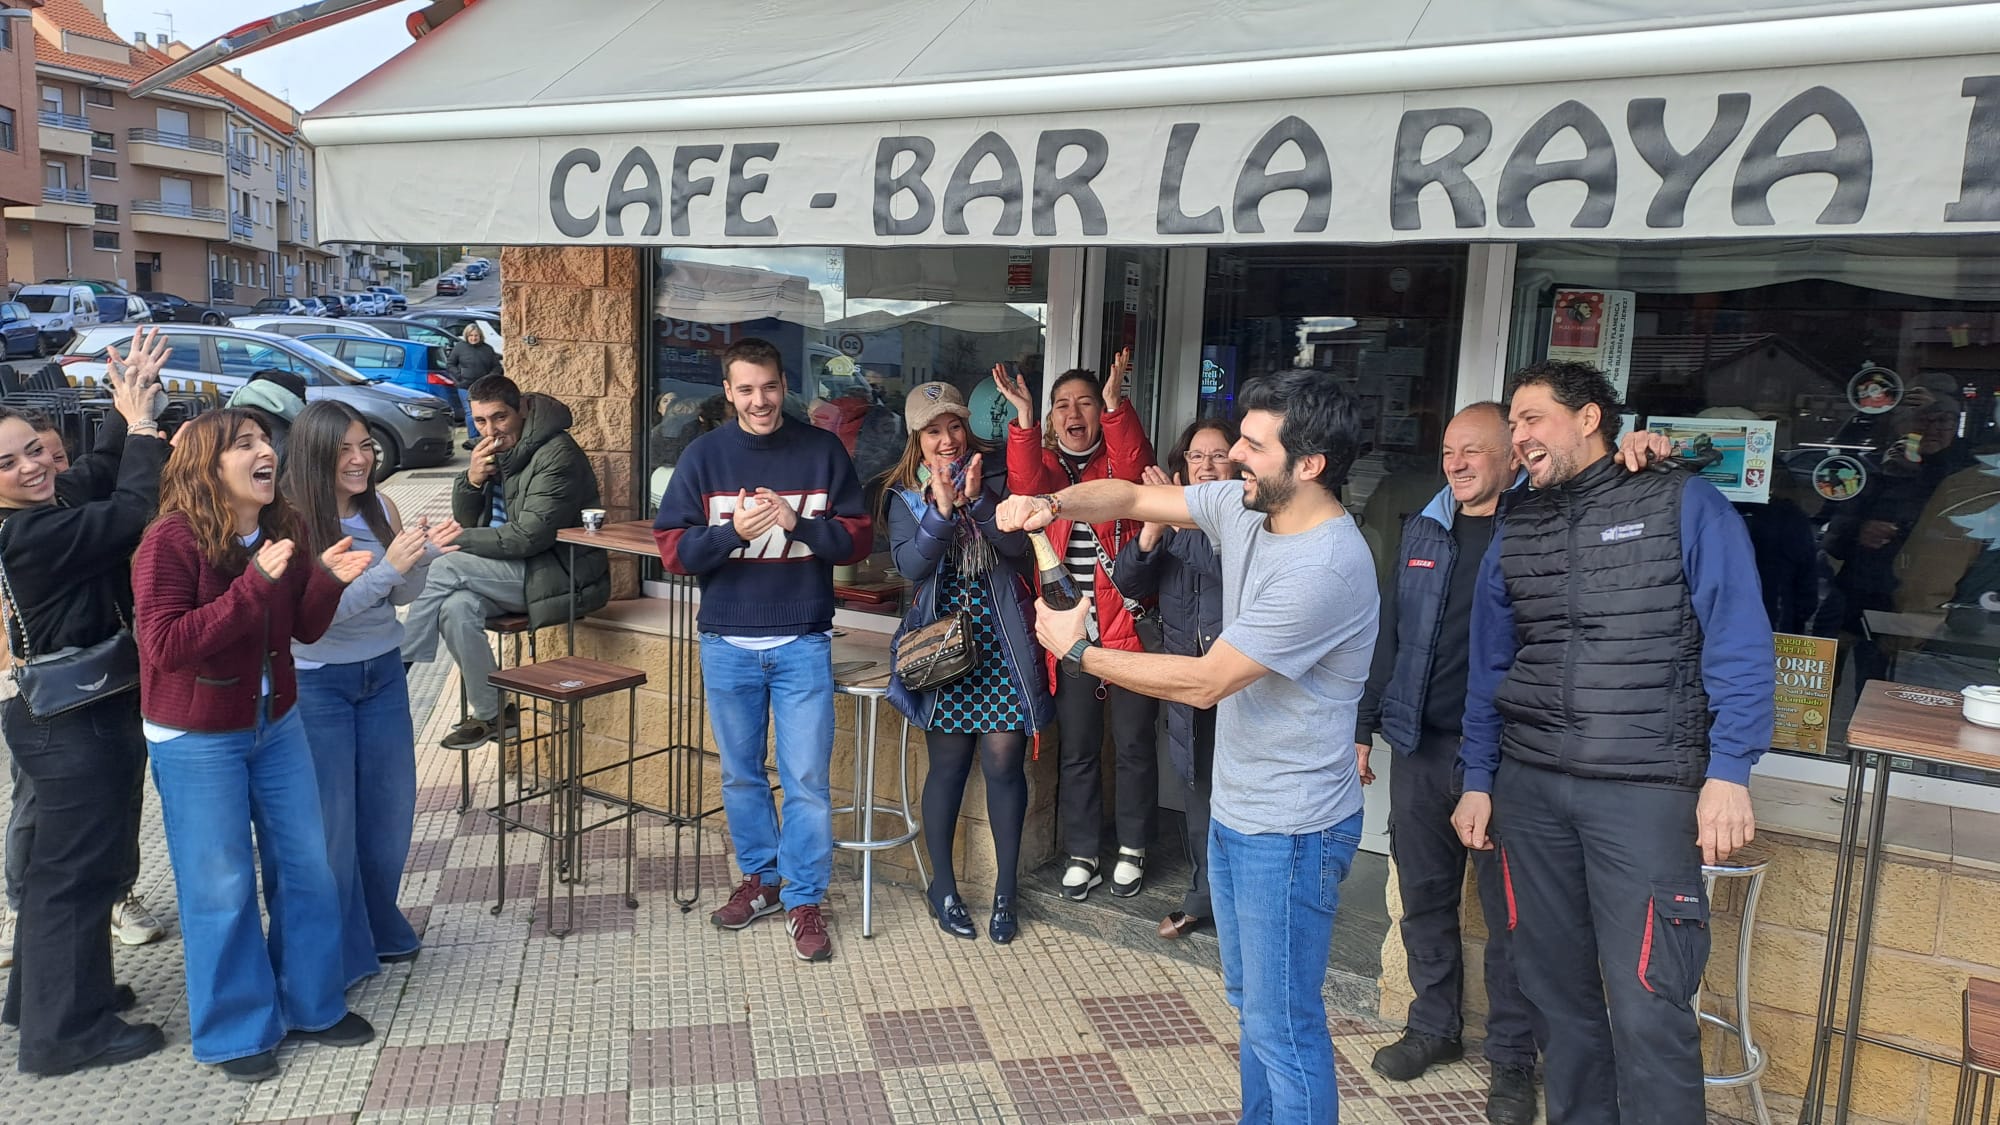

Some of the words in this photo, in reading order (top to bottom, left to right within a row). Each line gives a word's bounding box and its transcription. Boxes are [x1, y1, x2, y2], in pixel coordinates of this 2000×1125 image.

[549, 142, 780, 237] CAFE
[872, 127, 1110, 237] BAR
[1156, 114, 1332, 235] LA
[1390, 85, 1875, 229] RAYA
[1610, 302, 1620, 338] FLAMENCA
[1775, 656, 1831, 675] ORRE
